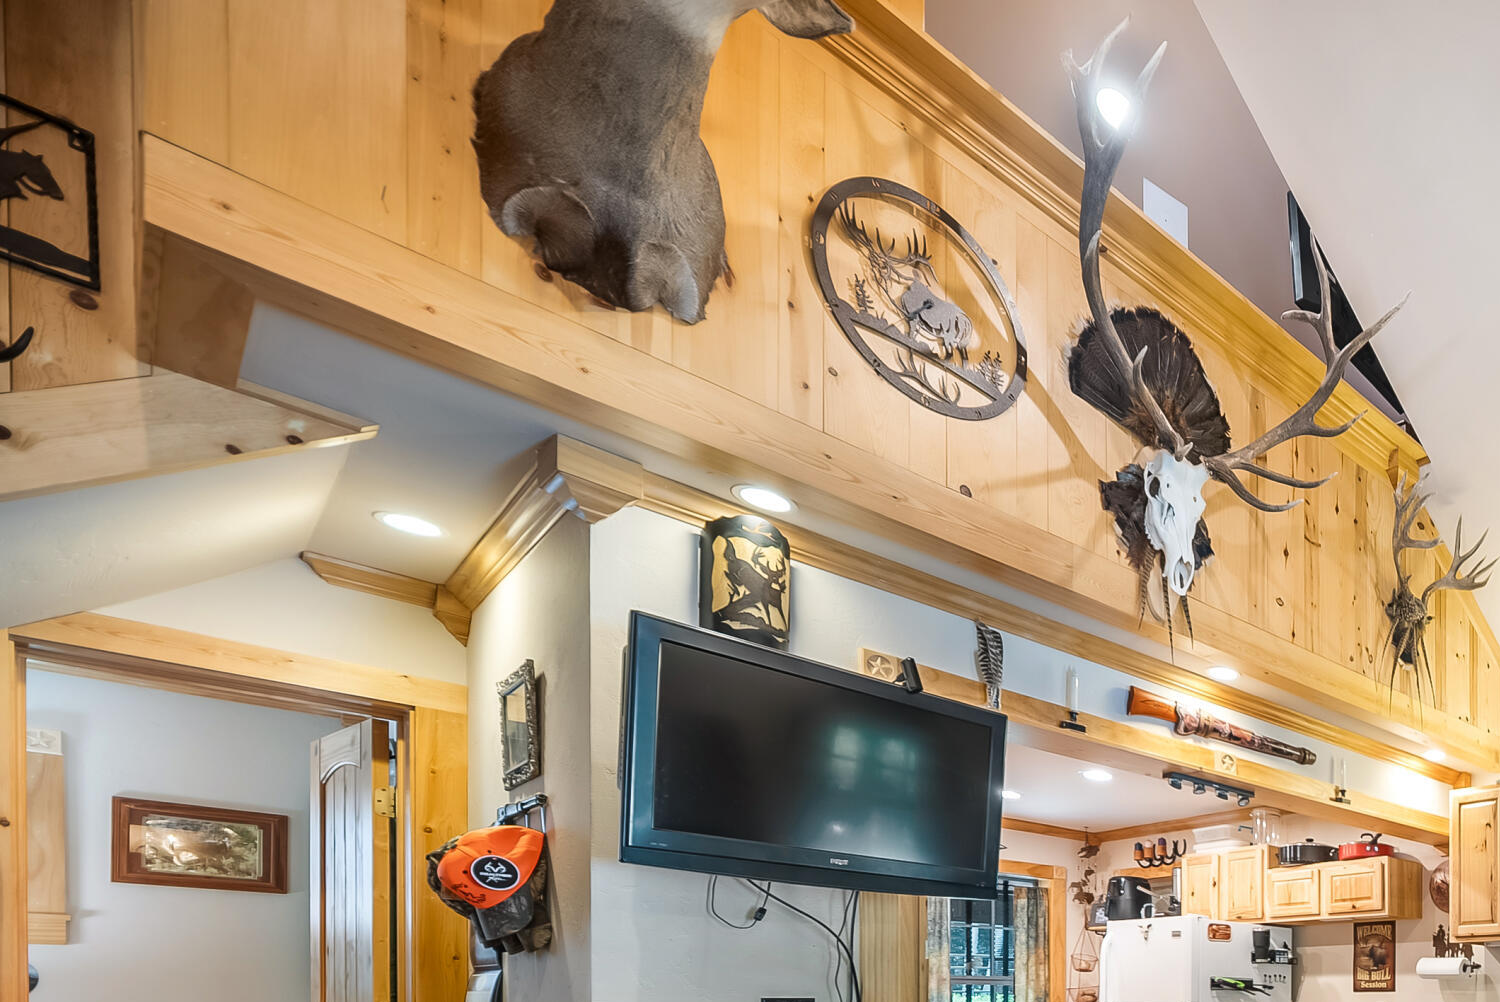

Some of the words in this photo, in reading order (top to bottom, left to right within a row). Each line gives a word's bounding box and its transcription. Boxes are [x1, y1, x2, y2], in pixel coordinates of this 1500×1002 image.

[1356, 924, 1393, 942] WELCOME
[1356, 967, 1370, 980] BIG
[1371, 967, 1391, 980] BULL
